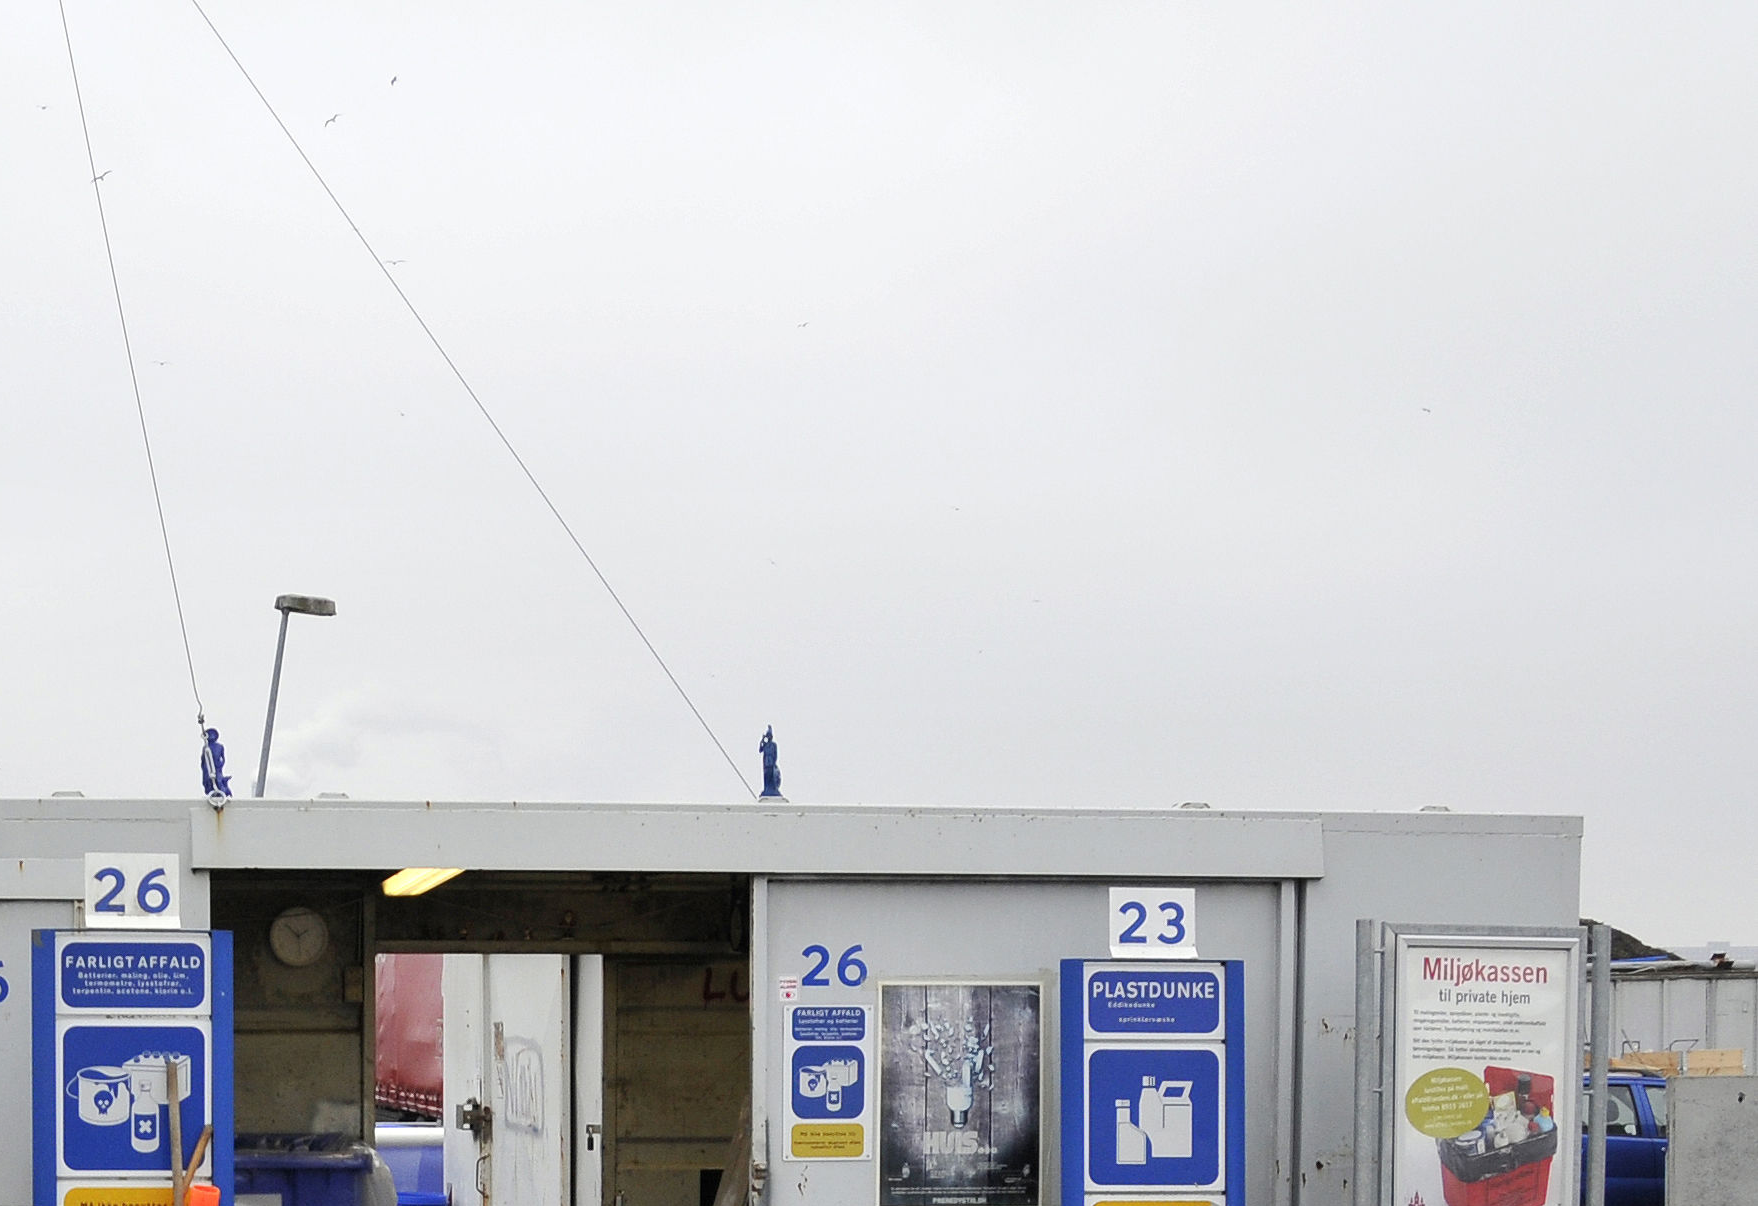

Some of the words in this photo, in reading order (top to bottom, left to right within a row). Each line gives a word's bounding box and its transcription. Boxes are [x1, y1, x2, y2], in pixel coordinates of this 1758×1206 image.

[94, 868, 170, 914] 26
[1119, 901, 1186, 944] 23
[65, 956, 134, 968] FARLIGT
[137, 956, 201, 968] AFFALD
[802, 944, 867, 987] 26
[1423, 957, 1548, 986] Miljøkassen
[1093, 981, 1215, 998] PLASTDUNKE
[1439, 989, 1451, 1002] til
[1455, 990, 1497, 1005] private
[1501, 990, 1531, 1007] hjem
